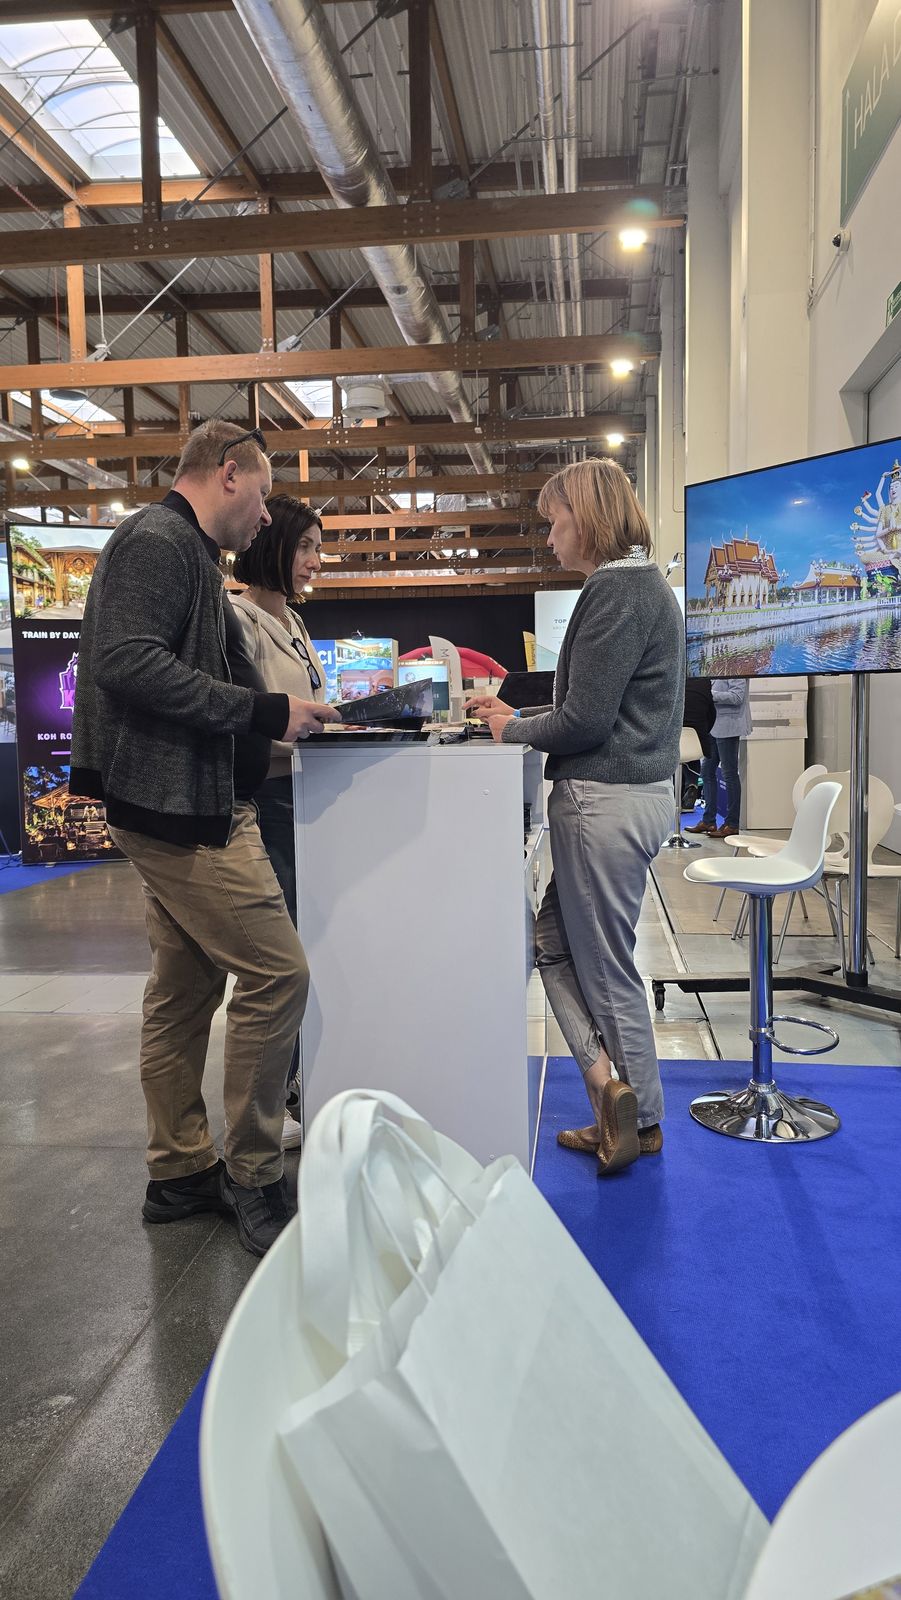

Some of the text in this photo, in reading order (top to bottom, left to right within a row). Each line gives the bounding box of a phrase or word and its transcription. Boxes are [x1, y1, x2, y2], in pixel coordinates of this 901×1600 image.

[854, 41, 889, 150] HALA
[22, 631, 48, 639] TRAIN
[49, 631, 61, 639] BY
